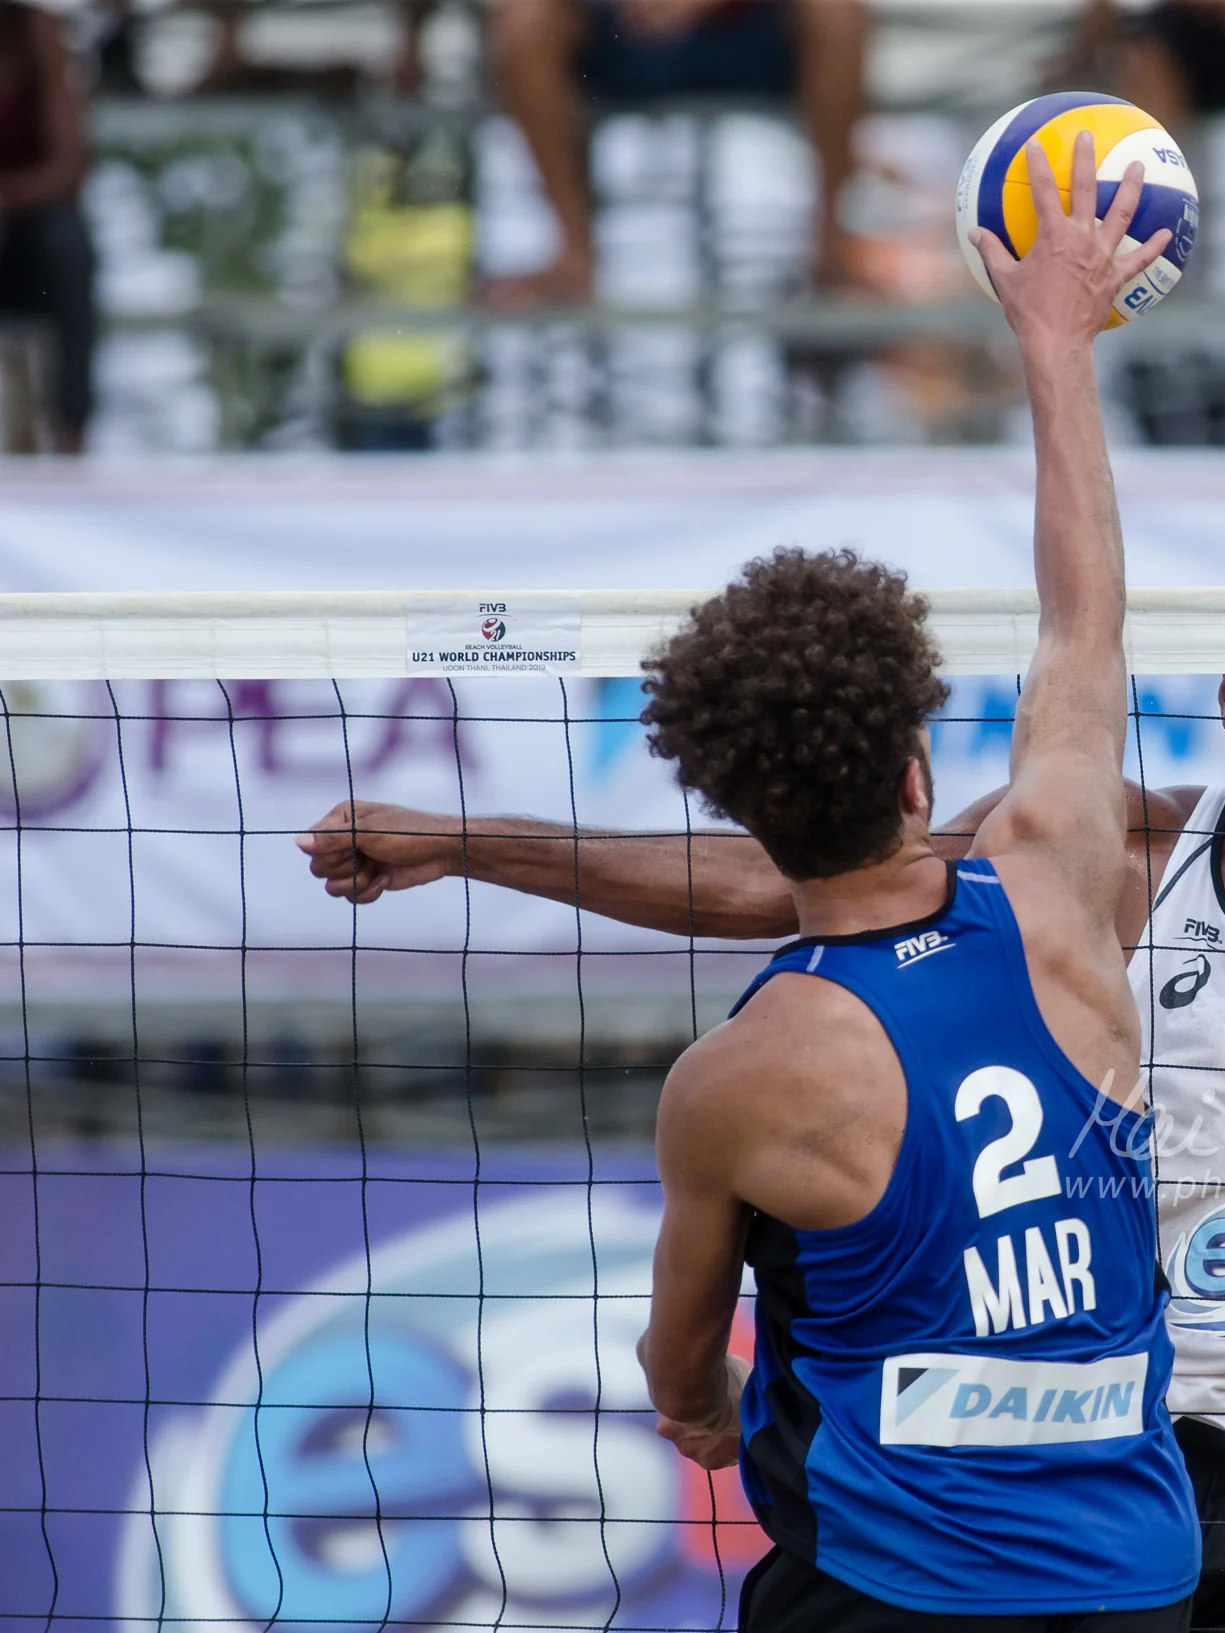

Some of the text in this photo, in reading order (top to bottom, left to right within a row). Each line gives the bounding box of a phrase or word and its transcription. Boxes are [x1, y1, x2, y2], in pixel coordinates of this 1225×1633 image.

[479, 603, 507, 613] FIVB
[412, 651, 576, 662] U21 WORLD CHAMPIONSHIPS
[442, 664, 465, 672] UDON
[1183, 918, 1221, 943] FIVB
[893, 930, 942, 961] FIVB
[954, 1065, 1063, 1219] 2
[963, 1217, 1097, 1338] MAR
[949, 1381, 1136, 1425] DAIKIN
